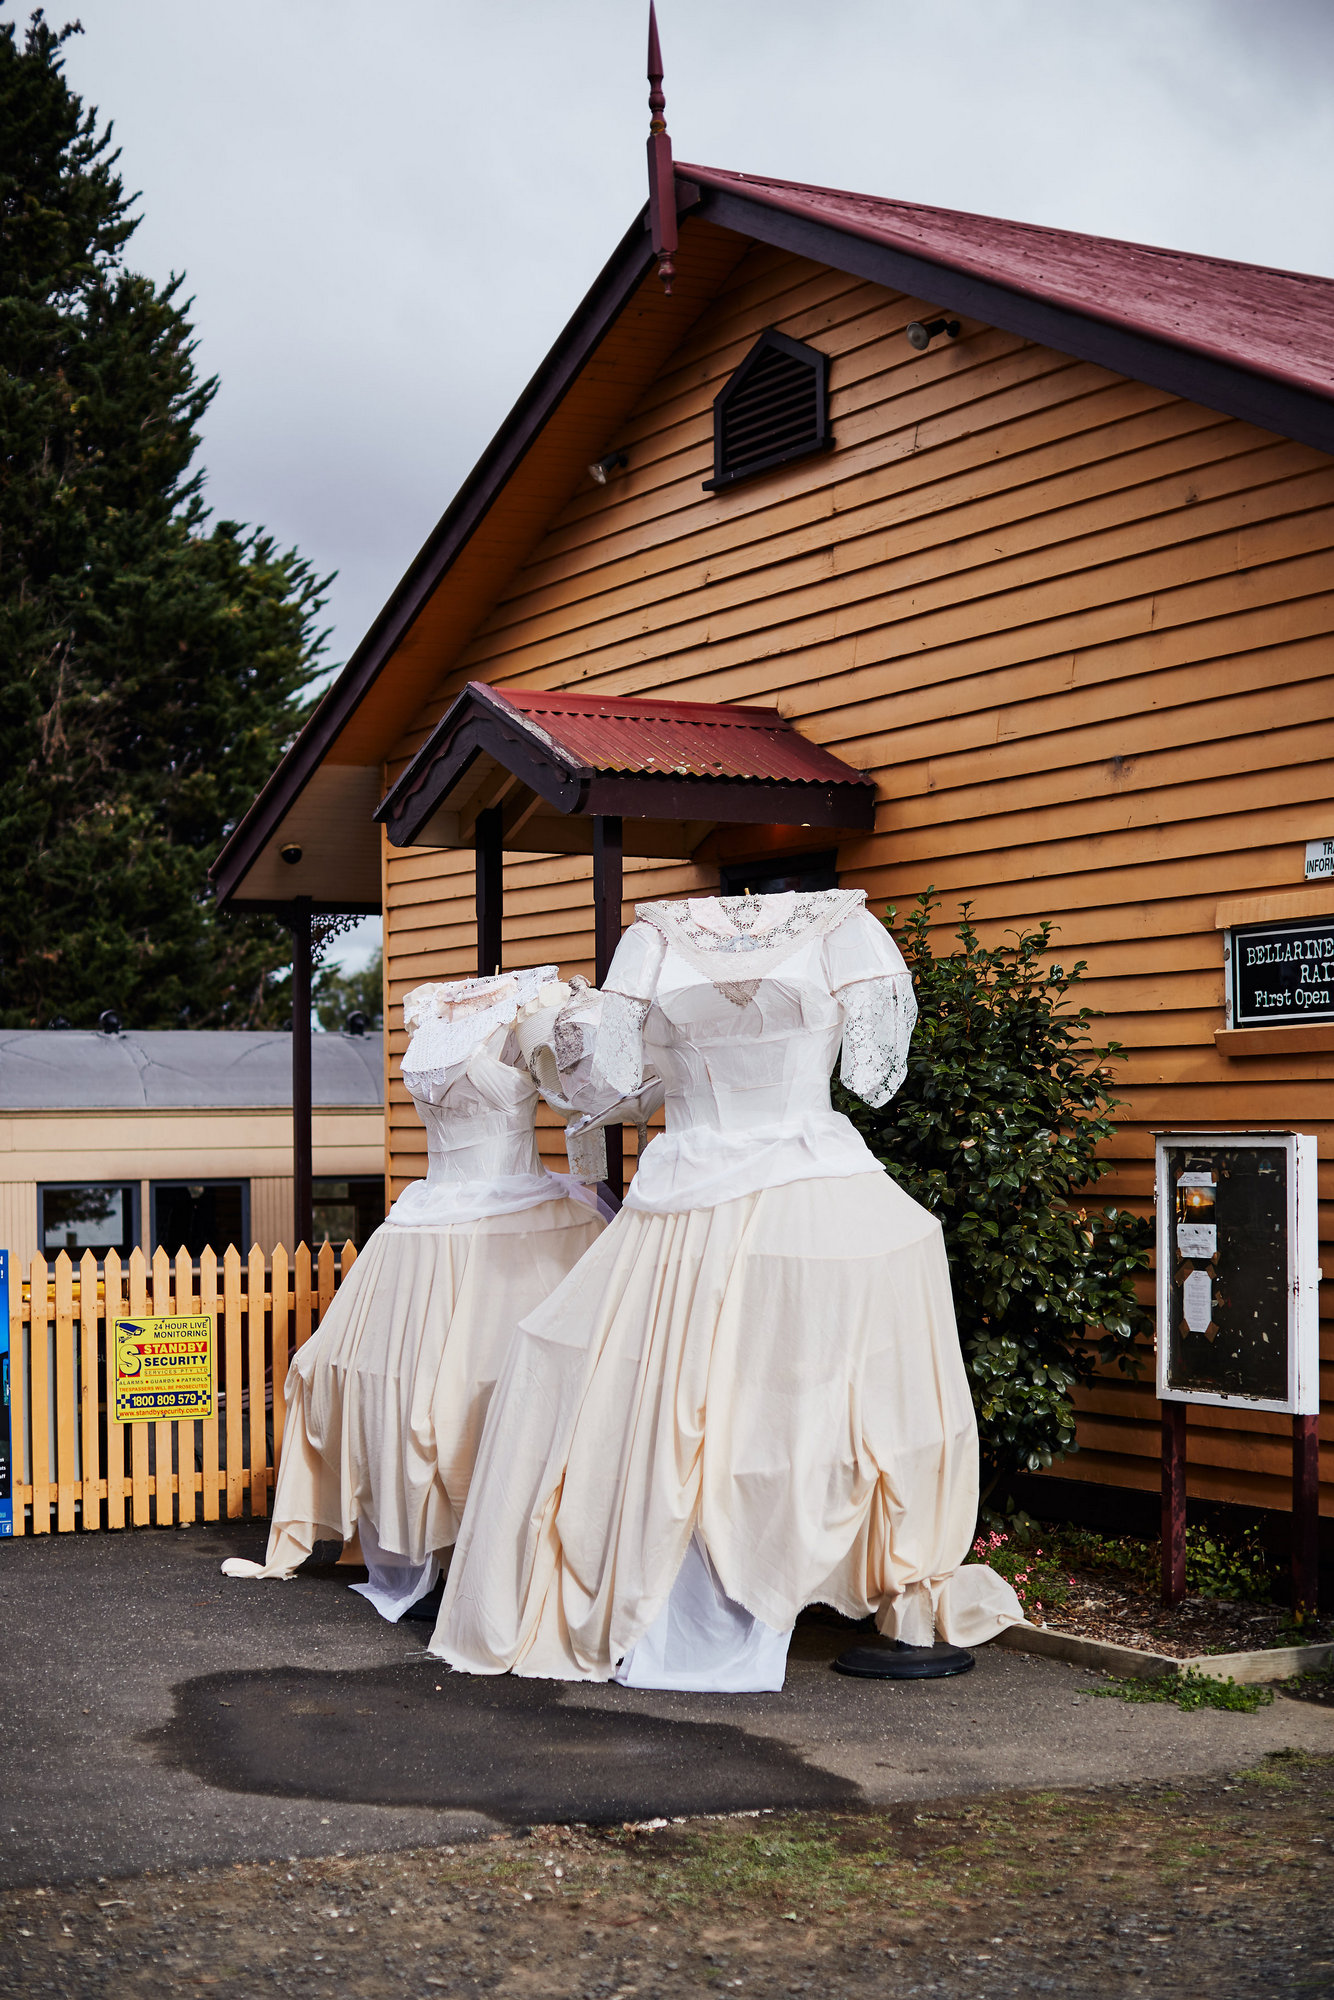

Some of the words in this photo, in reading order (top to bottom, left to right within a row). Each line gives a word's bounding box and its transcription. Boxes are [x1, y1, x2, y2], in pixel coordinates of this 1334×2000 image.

[1246, 937, 1334, 967] BELLARINE
[1254, 988, 1292, 1008] First
[1295, 988, 1331, 1009] Open
[164, 1322, 188, 1330] HOUR
[190, 1321, 207, 1329] LIVE
[153, 1329, 208, 1339] MONITORING
[143, 1342, 205, 1355] STANDBY
[144, 1355, 208, 1367] SECURITY
[132, 1395, 155, 1407] 1800
[156, 1394, 176, 1405] 809
[177, 1393, 197, 1404] 579
[119, 1407, 209, 1417] www.standbysecurity.com.au
